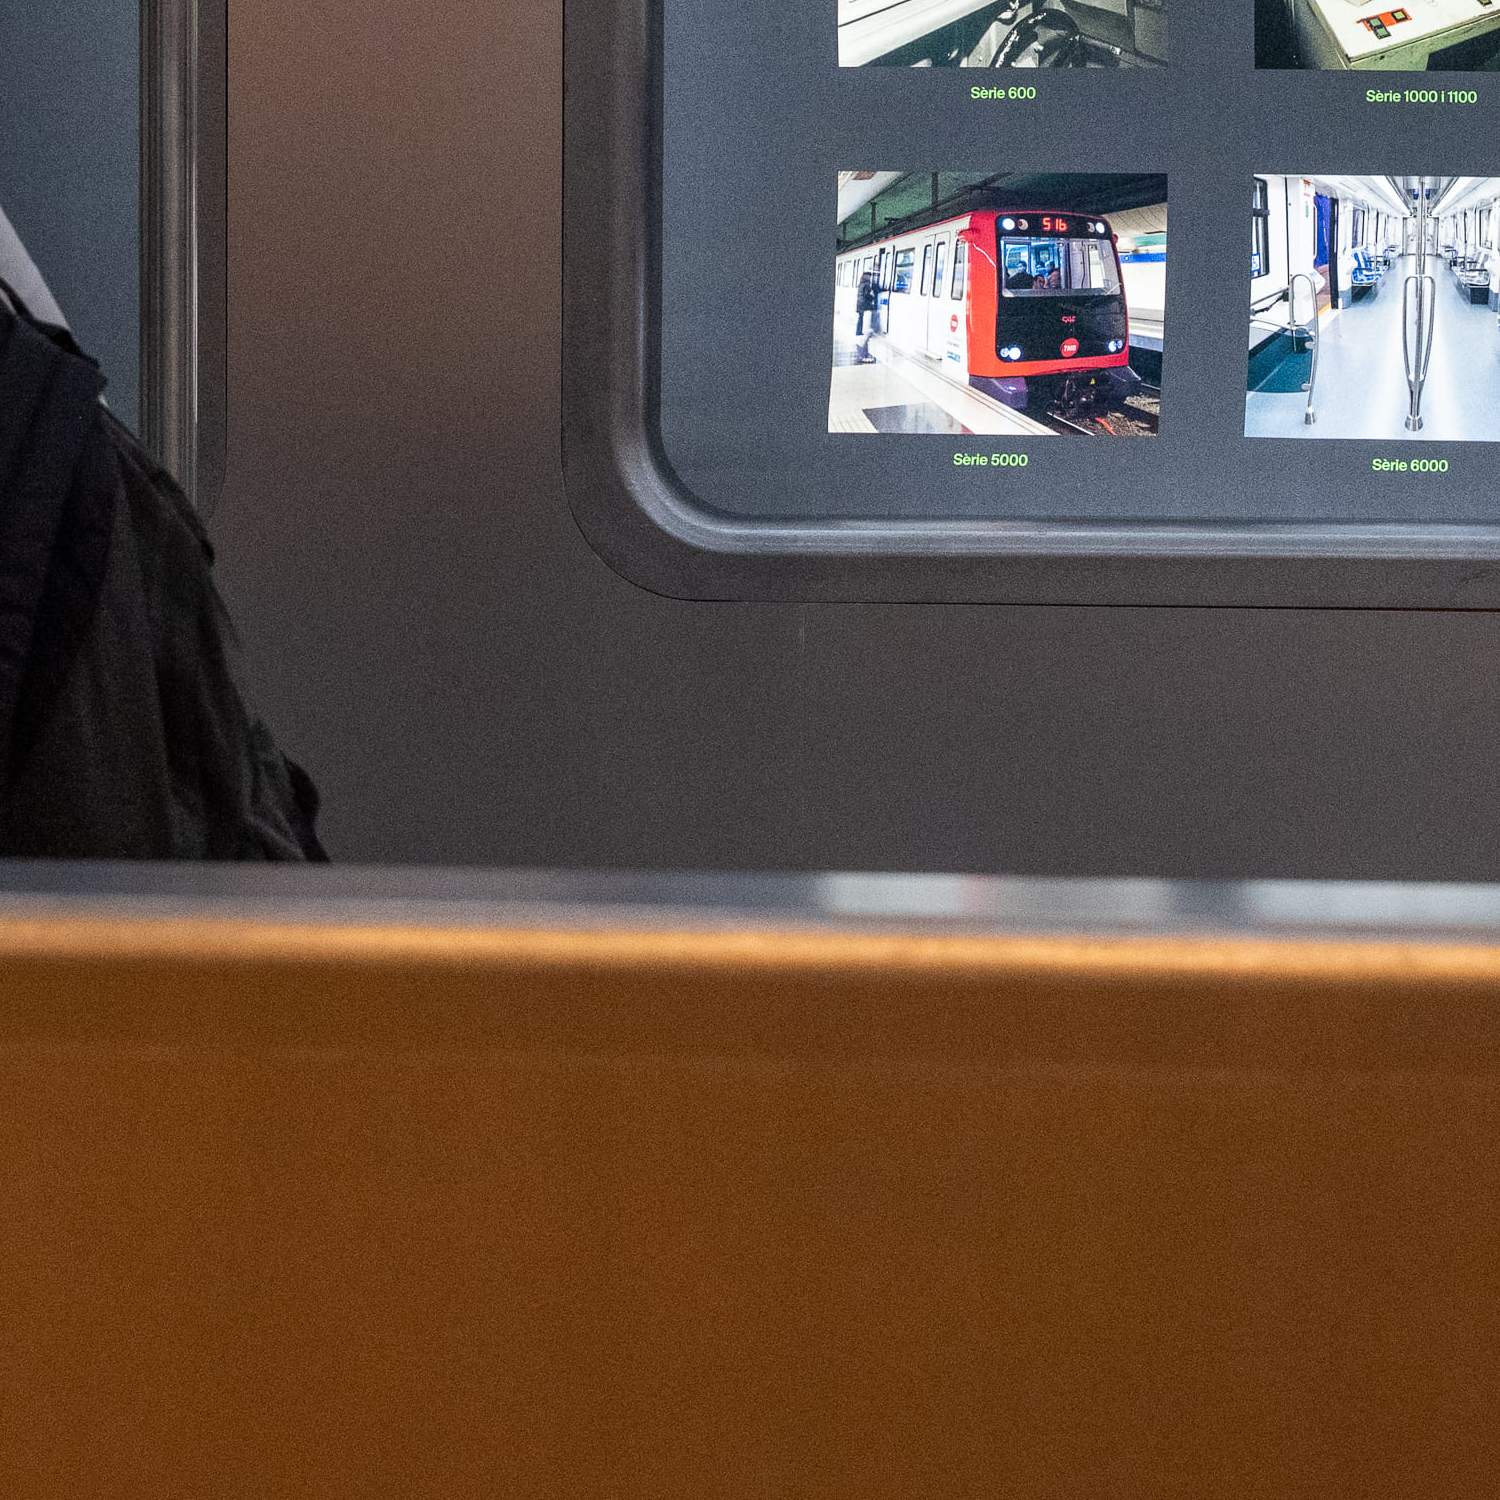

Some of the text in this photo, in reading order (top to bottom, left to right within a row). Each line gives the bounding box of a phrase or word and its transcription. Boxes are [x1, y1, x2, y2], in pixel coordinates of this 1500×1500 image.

[970, 85, 1037, 100] Sèrie 600
[1365, 89, 1478, 104] Sèrie 1000 i 1100
[952, 452, 1029, 468] Sèrie 5000
[1371, 457, 1450, 473] Sèrie 6000
